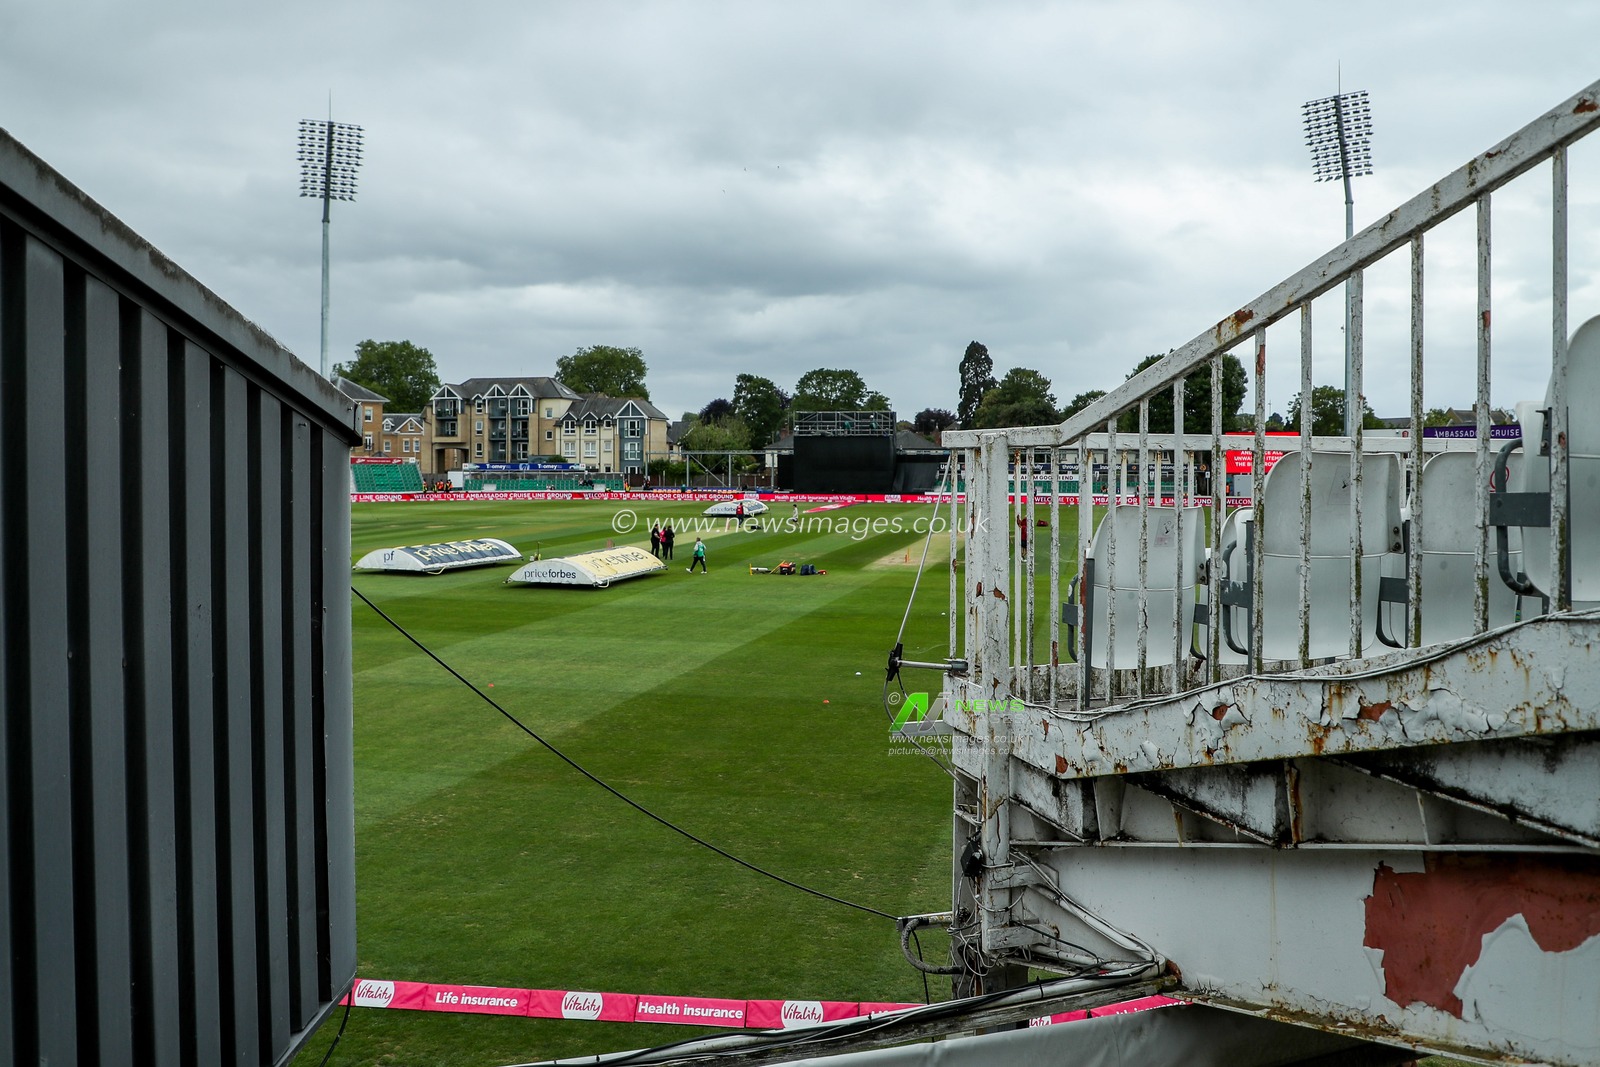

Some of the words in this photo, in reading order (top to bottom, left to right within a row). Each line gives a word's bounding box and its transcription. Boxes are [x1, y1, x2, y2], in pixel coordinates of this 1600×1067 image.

[1434, 428, 1477, 438] AMBASSAD
[384, 550, 394, 562] pf
[356, 982, 392, 1004] Vitality
[435, 992, 458, 1004] Life
[460, 993, 518, 1007] insurance
[564, 994, 601, 1015] Vitality
[638, 1002, 680, 1015] Health
[683, 1004, 744, 1019] insurance
[783, 1003, 822, 1024] Vitality
